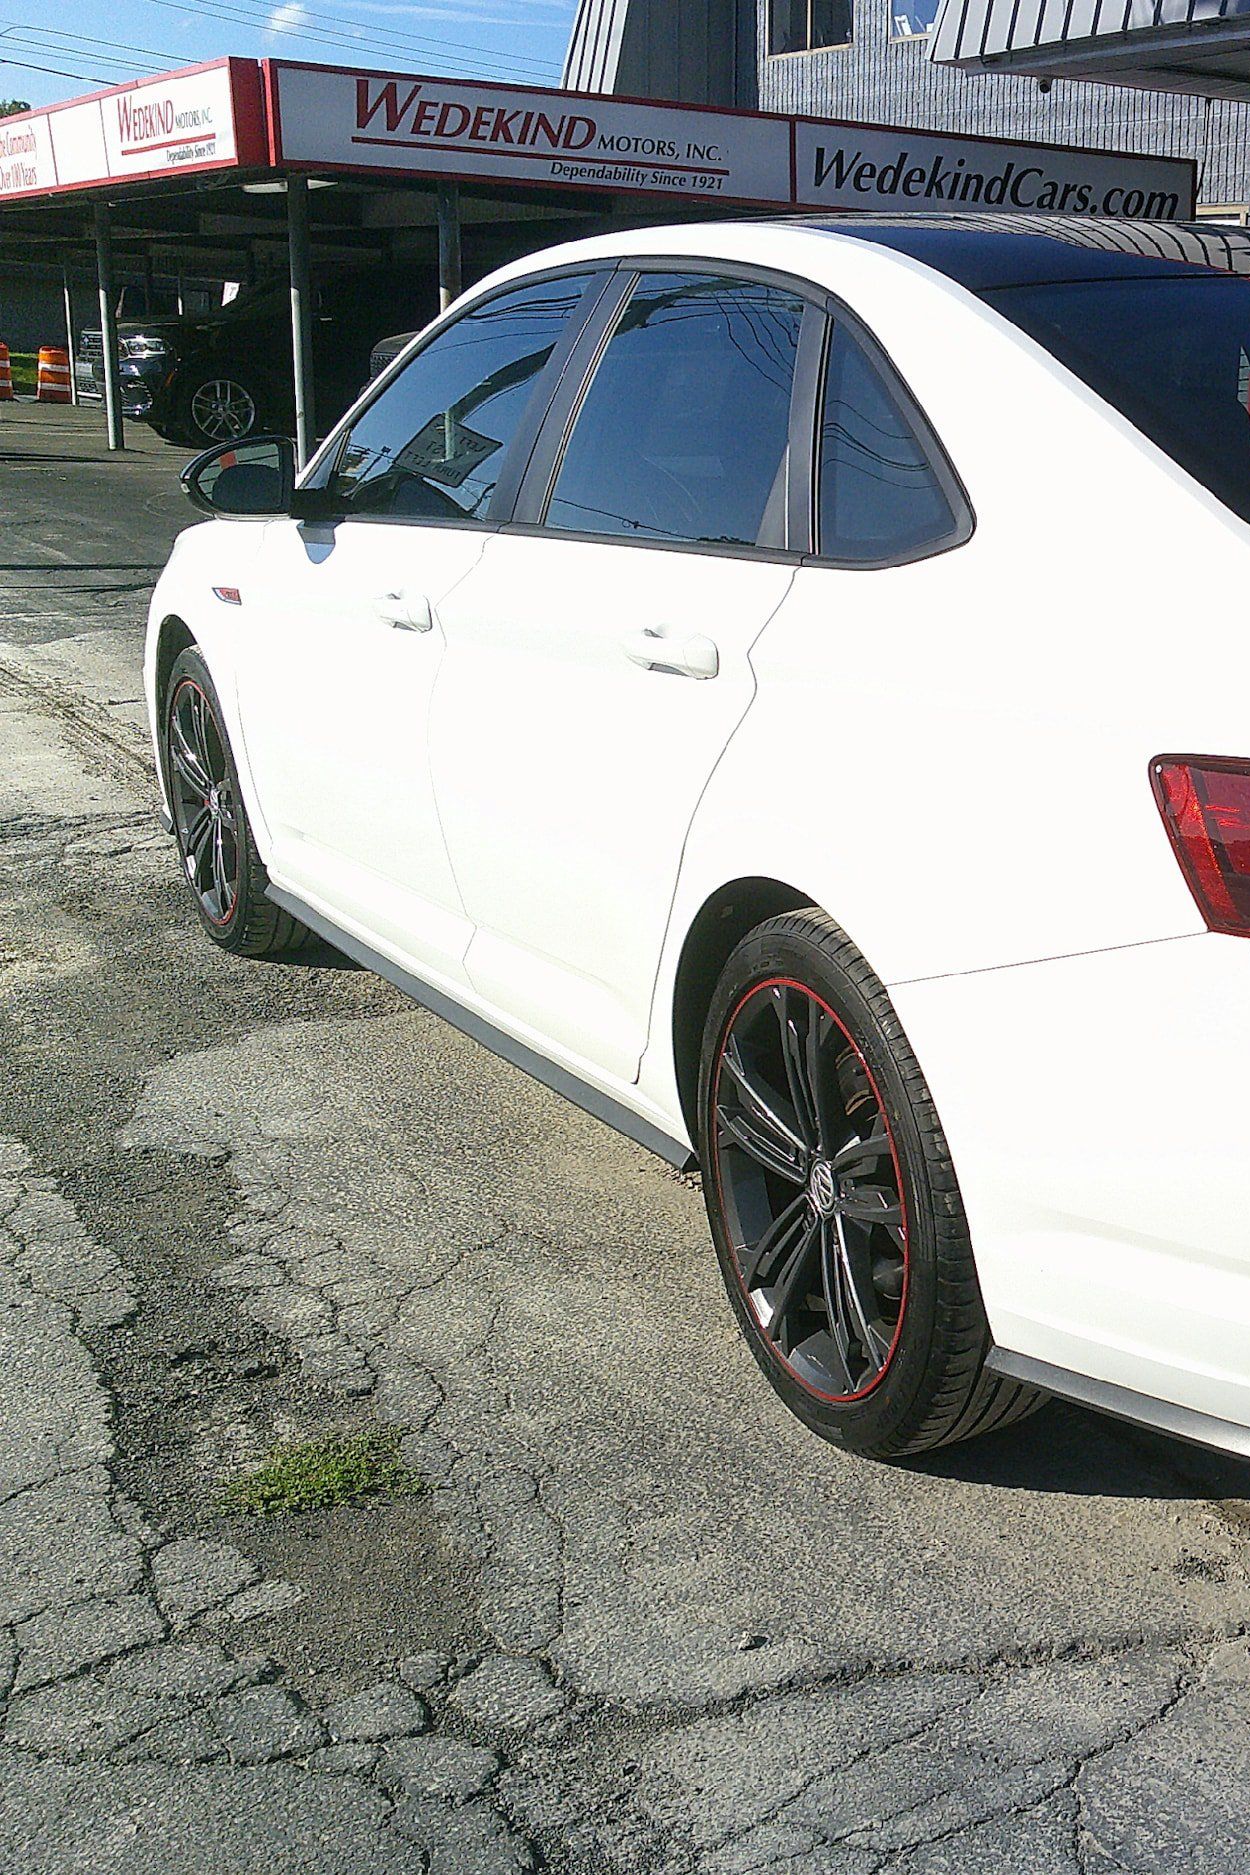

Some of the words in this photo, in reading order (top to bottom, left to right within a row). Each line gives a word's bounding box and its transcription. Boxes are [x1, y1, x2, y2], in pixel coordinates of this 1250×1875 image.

[356, 79, 597, 150] WEDEKIND
[597, 134, 681, 160] MOTORS,
[686, 143, 722, 161] INC.
[551, 162, 648, 186] Dependability
[651, 170, 687, 187] Since
[691, 175, 723, 190] 1921
[813, 147, 1180, 219] WedekindCars.com
